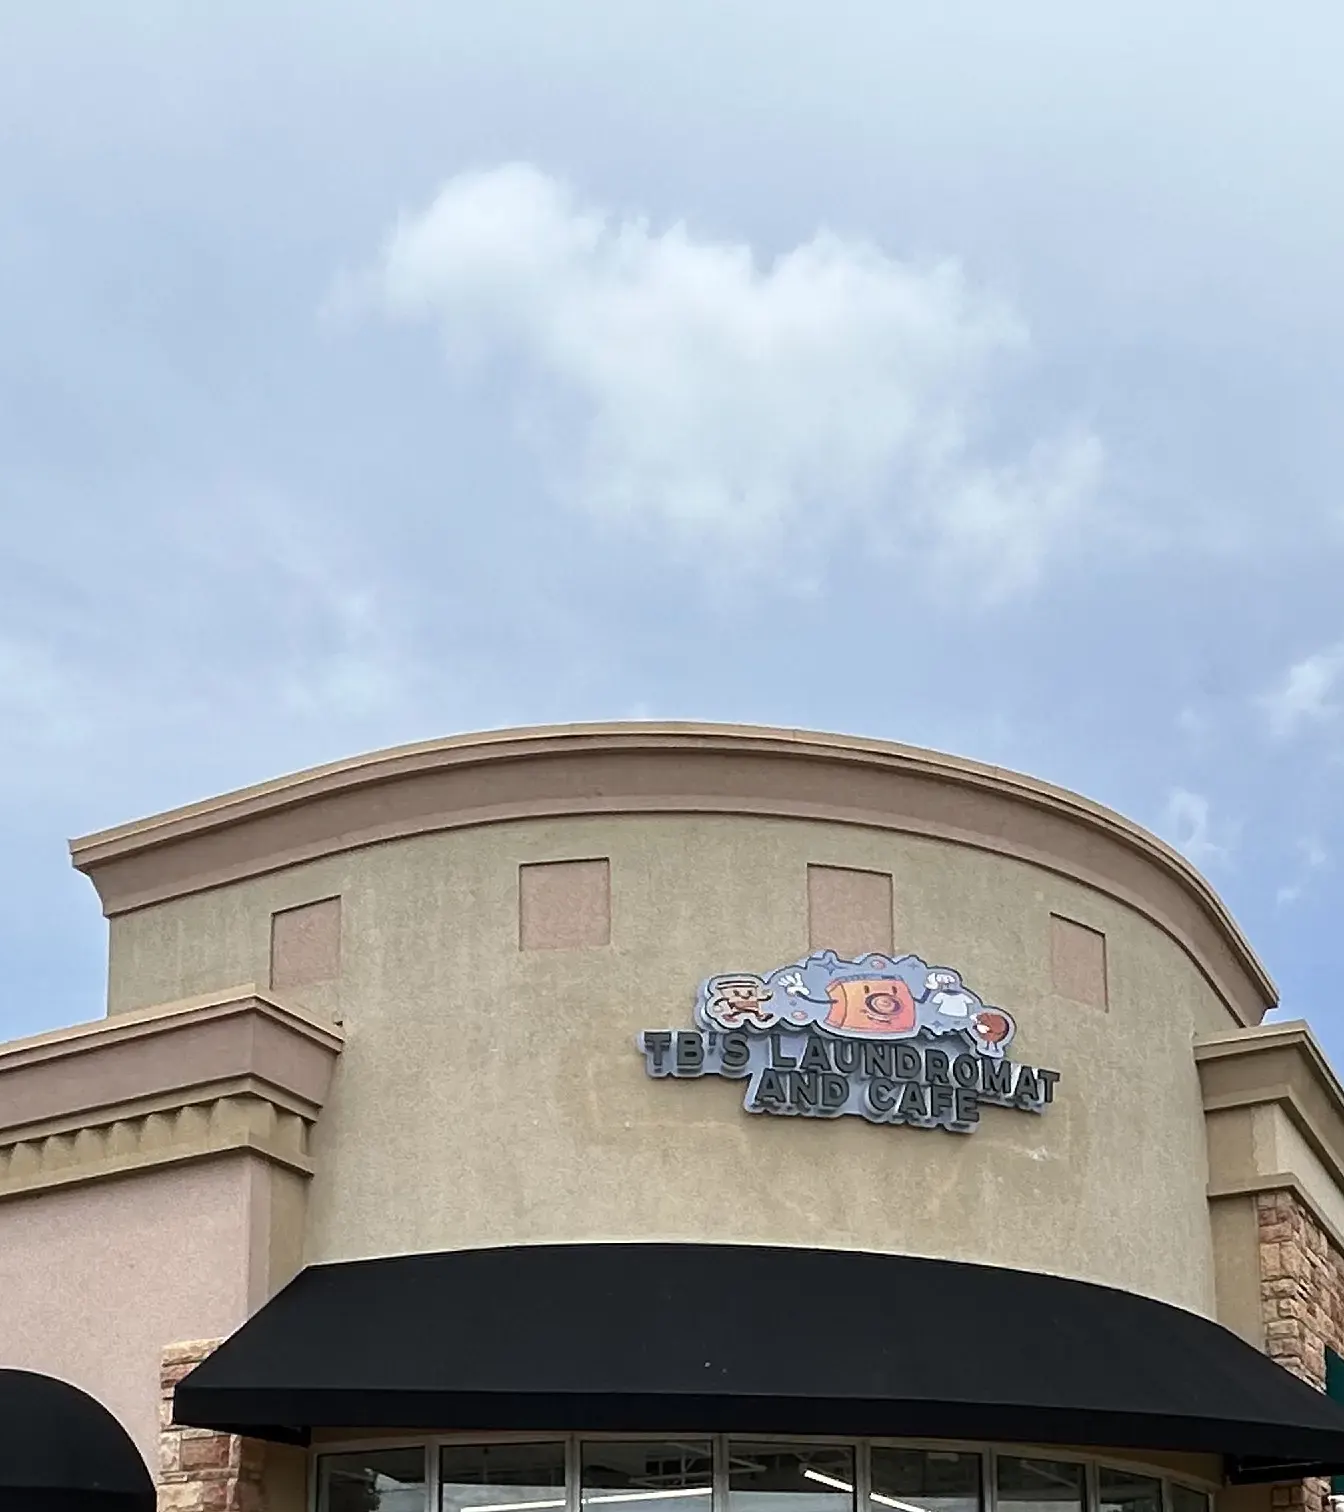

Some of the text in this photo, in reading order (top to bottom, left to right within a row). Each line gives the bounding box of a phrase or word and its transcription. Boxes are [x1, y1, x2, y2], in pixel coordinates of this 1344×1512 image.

[643, 1031, 1061, 1104] TB'S LAUNDROMAT
[755, 1068, 981, 1123] AND CAFE
